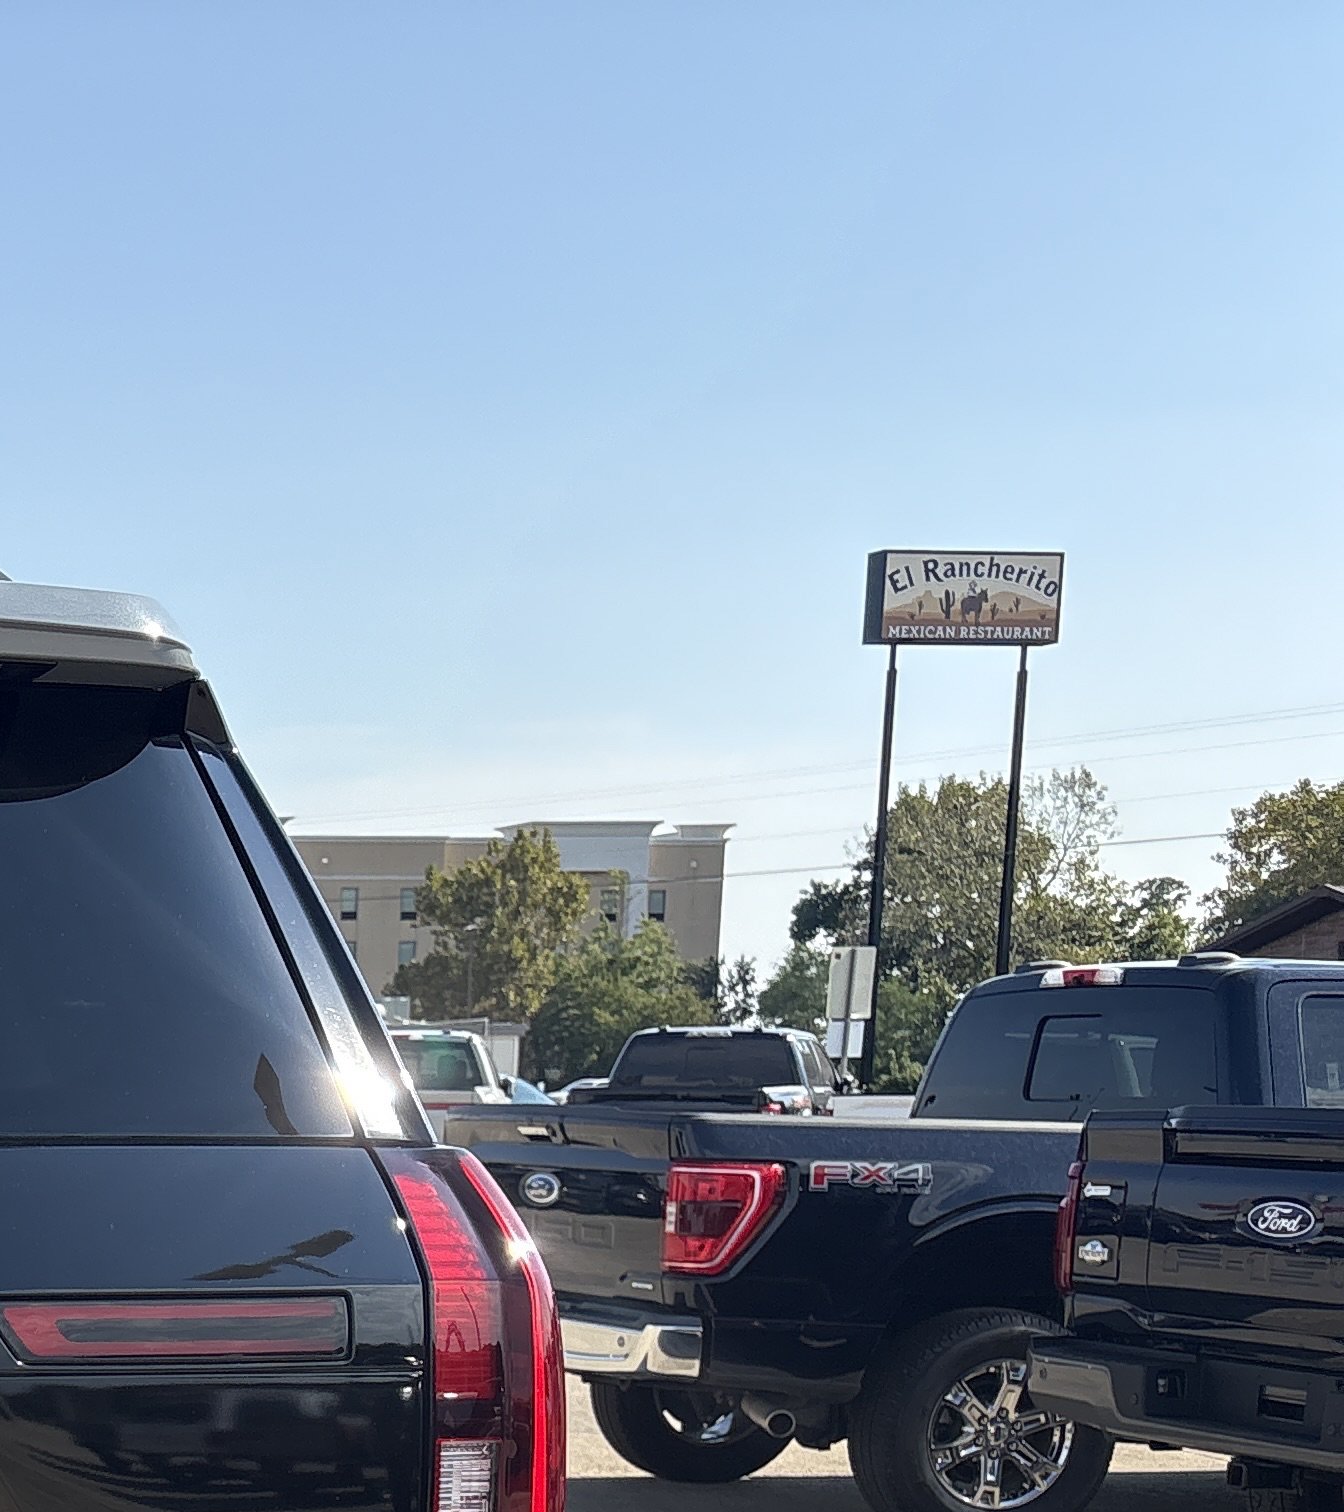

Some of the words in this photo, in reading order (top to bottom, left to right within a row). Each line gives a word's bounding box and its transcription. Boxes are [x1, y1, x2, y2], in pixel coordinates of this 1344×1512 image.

[887, 565, 915, 595] El
[922, 556, 1059, 598] Rancherito
[887, 625, 955, 639] MEXICAN
[959, 626, 1053, 640] RESTAURANT
[809, 1160, 933, 1192] FX4
[1257, 1206, 1304, 1231] Ford
